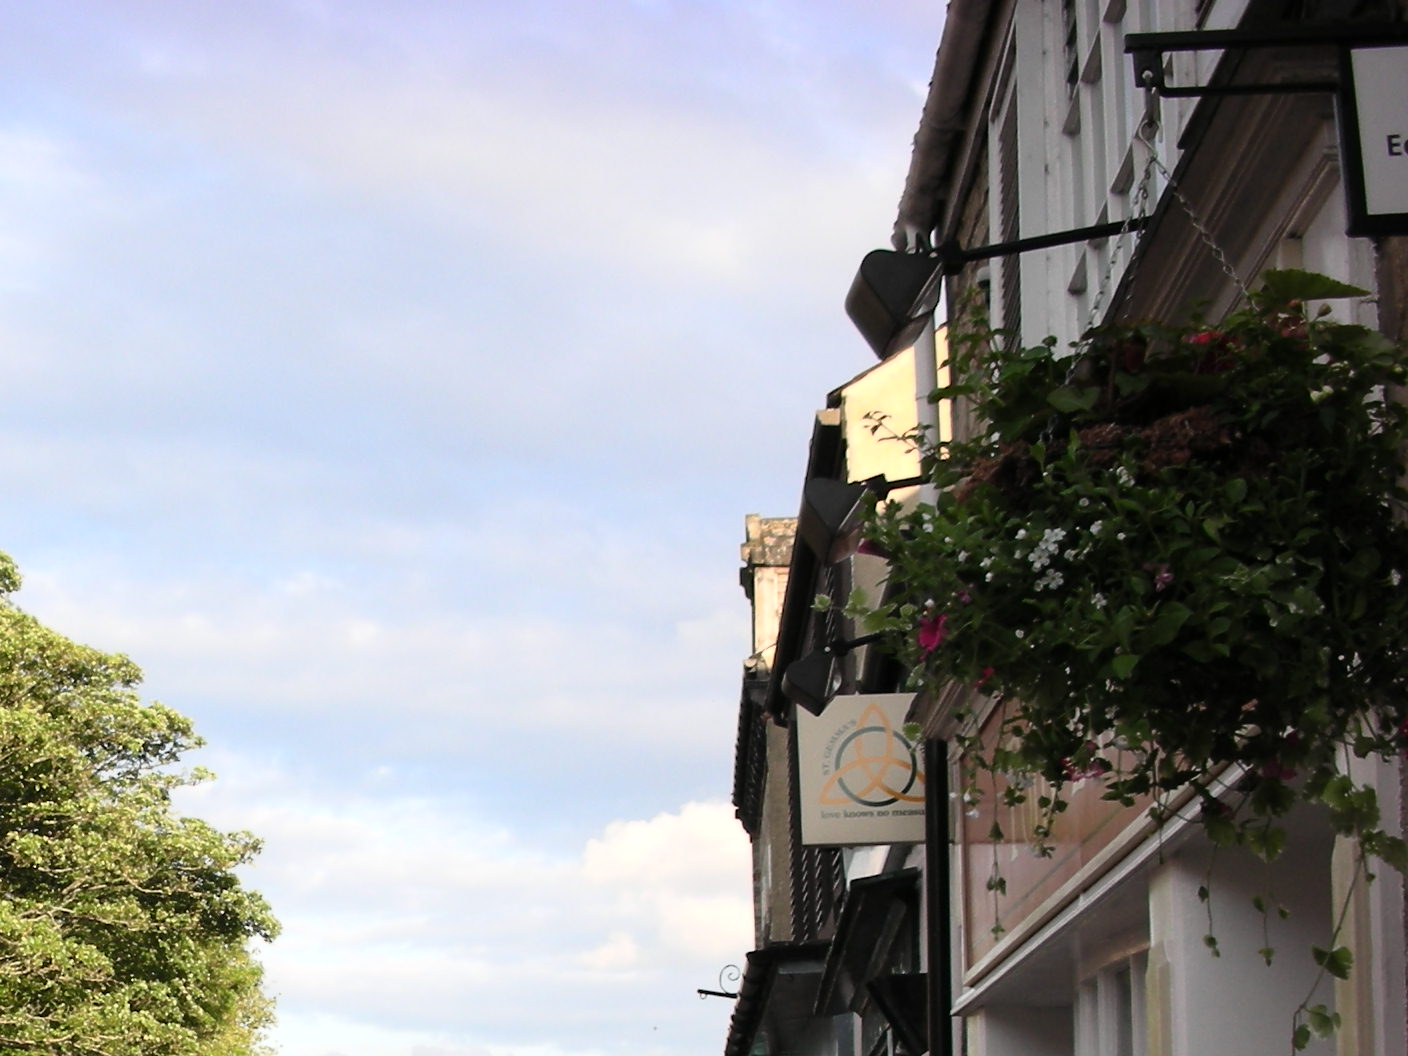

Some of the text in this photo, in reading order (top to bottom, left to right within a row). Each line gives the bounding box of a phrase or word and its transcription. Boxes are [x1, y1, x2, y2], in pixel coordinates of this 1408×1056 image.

[821, 810, 841, 818] love
[843, 809, 874, 818] knows
[877, 809, 890, 817] no
